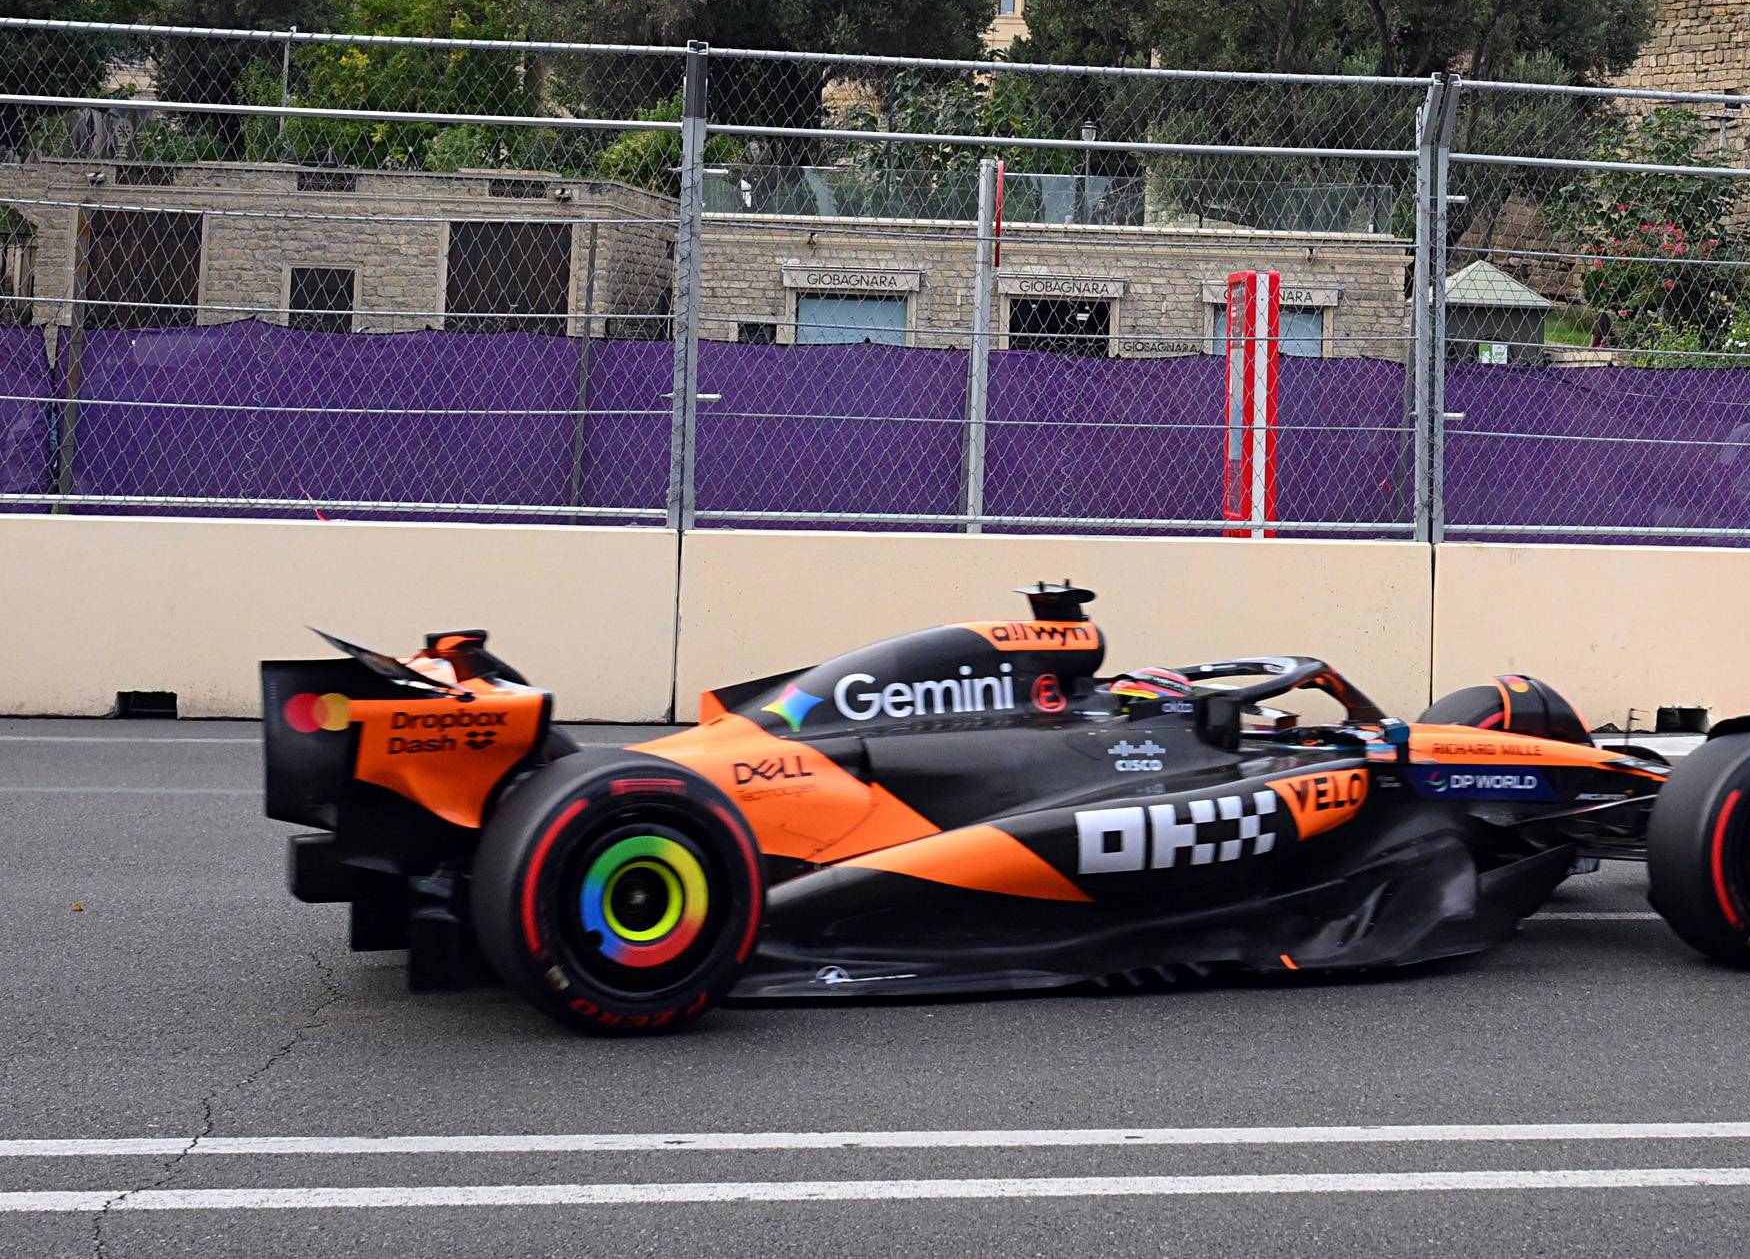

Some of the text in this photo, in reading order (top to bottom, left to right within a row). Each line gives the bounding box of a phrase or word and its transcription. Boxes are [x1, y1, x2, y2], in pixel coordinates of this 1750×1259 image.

[806, 273, 897, 287] GIOBAGNARA
[1019, 280, 1110, 295] GIOBAGNARA
[1123, 341, 1199, 353] GIOBAGNARA
[833, 662, 1015, 721] Gemini
[391, 711, 508, 732] Dropbox
[390, 735, 456, 754] Dash
[1432, 743, 1543, 756] RICHARD MILLE
[732, 755, 813, 784] DELL
[1450, 775, 1538, 789] DP WORLD
[1288, 773, 1364, 813] VELO
